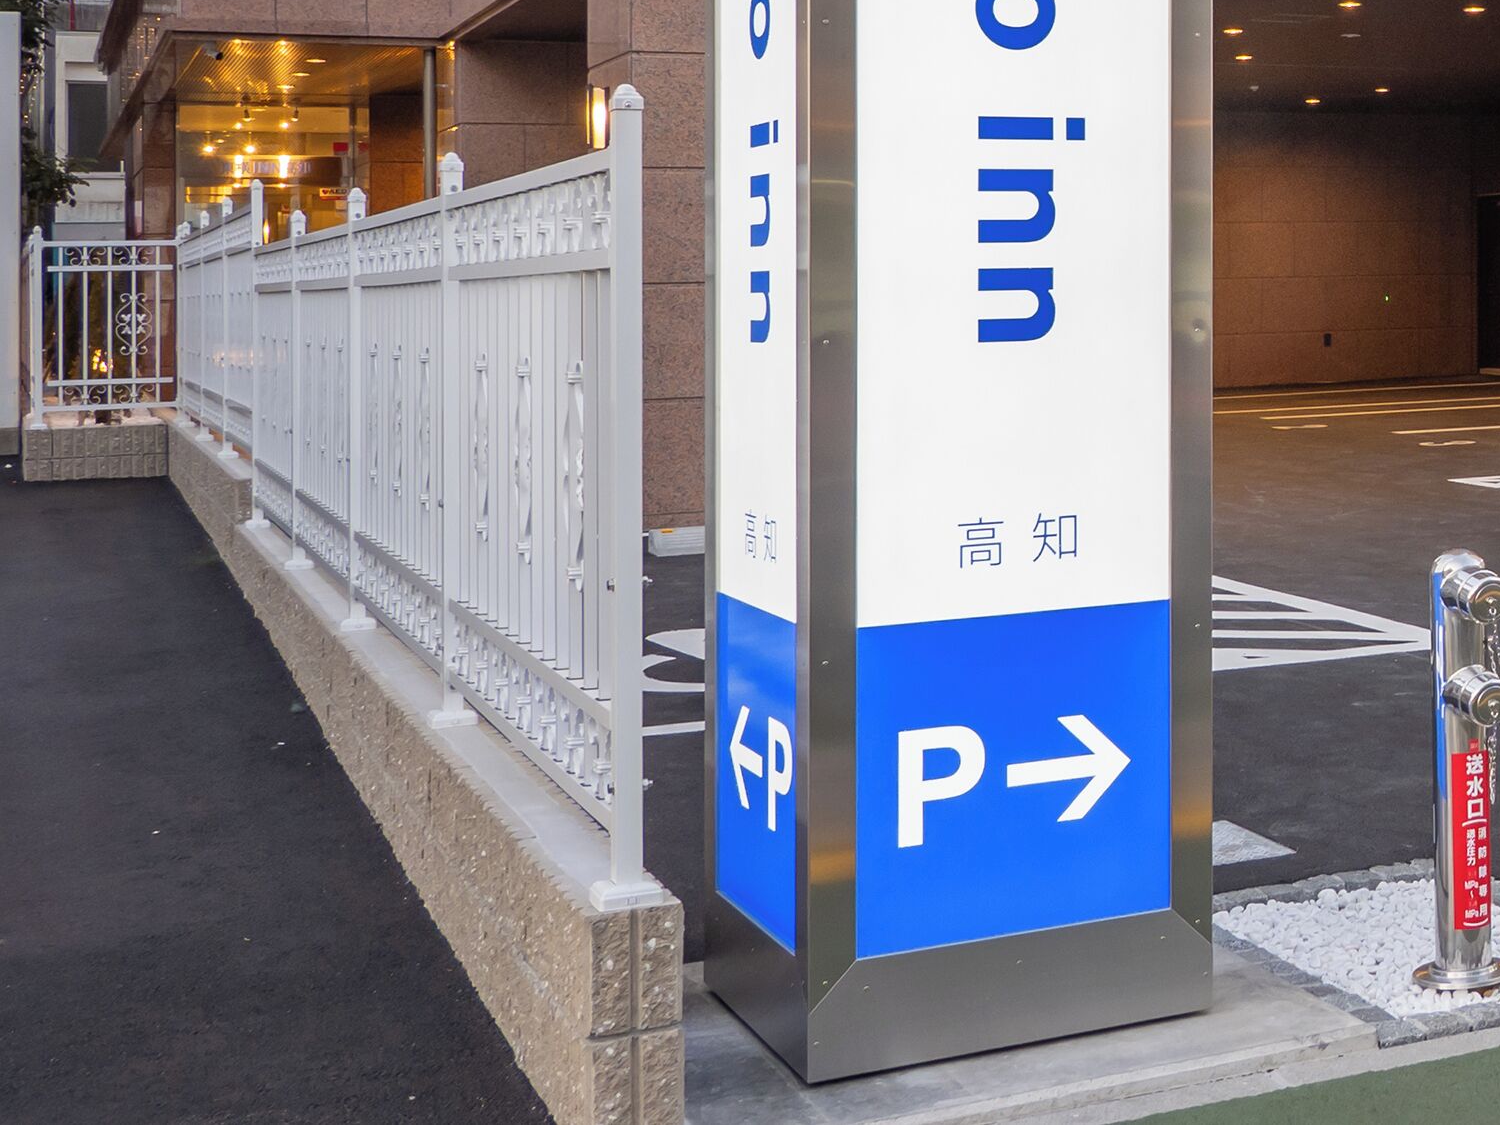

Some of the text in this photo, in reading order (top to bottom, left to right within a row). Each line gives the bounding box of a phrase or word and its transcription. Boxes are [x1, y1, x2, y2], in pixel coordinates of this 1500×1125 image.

[749, 119, 780, 344] inn
[977, 115, 1087, 344] inn
[744, 508, 778, 565] 高知
[957, 512, 1080, 569] 高知
[767, 715, 793, 833] P
[897, 724, 987, 850] P
[1465, 753, 1484, 820] 送水口
